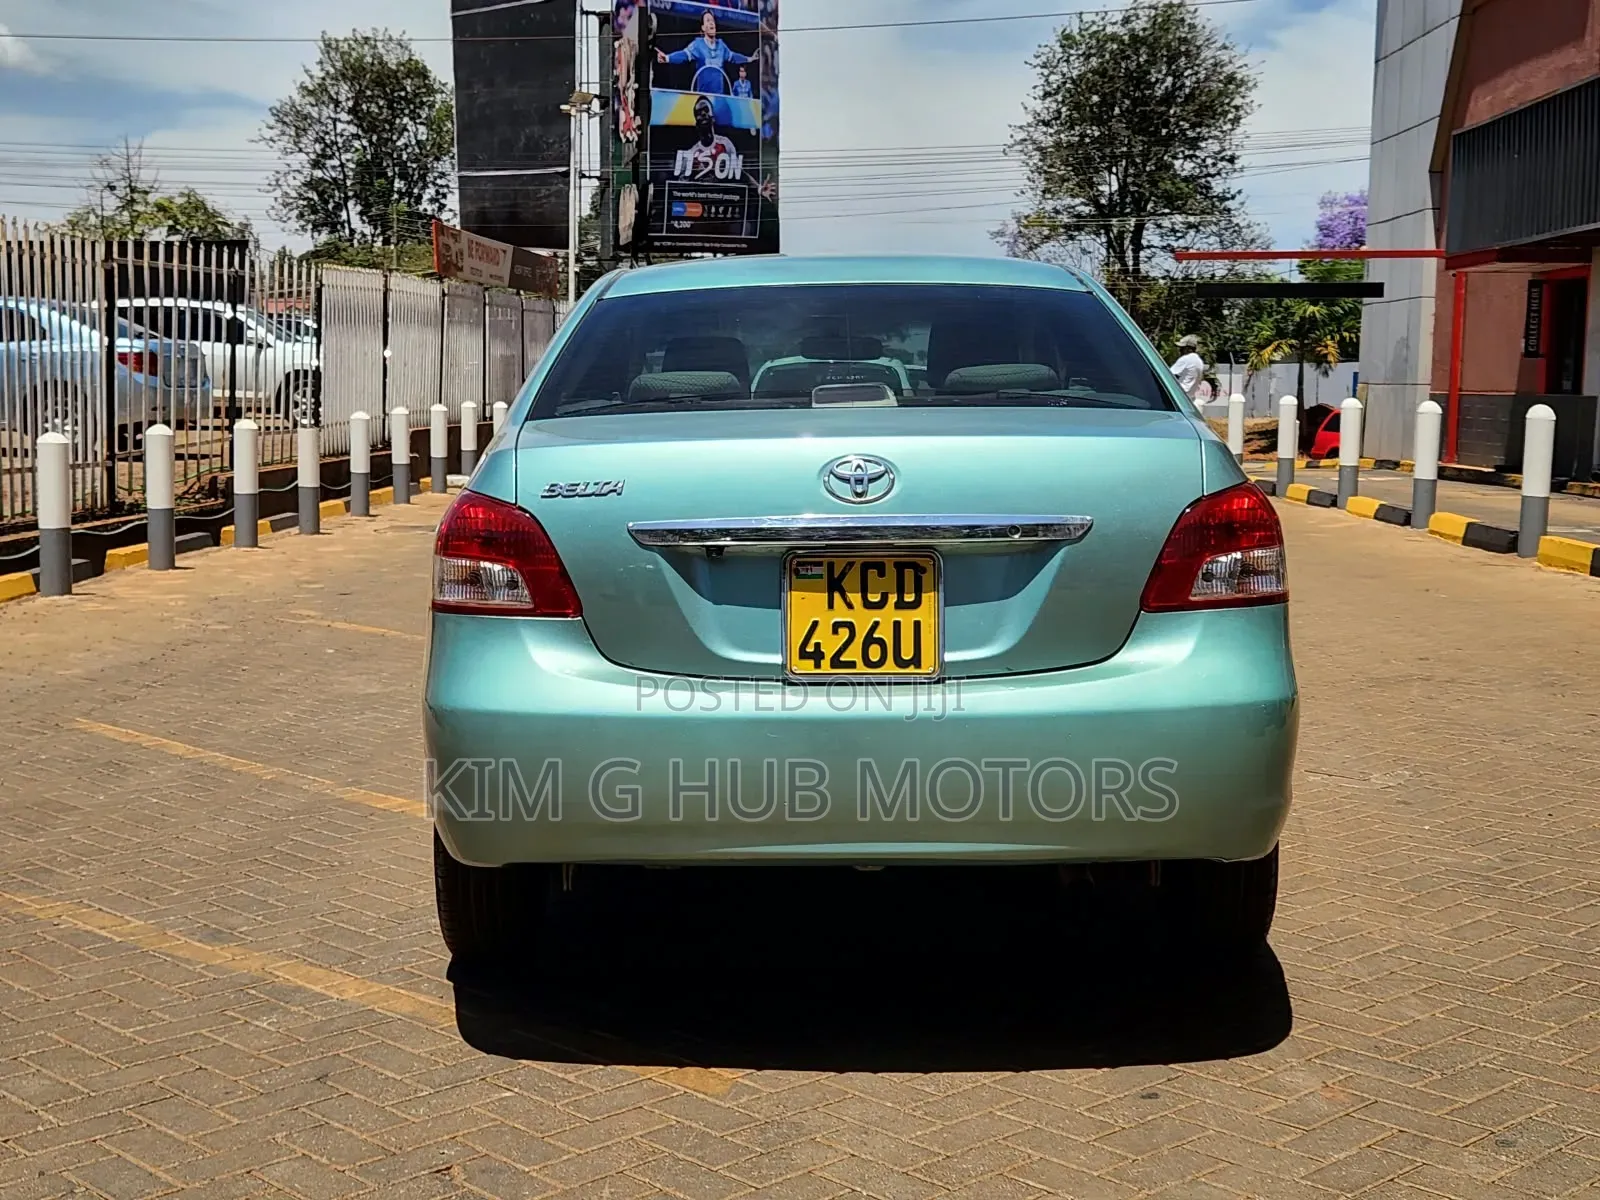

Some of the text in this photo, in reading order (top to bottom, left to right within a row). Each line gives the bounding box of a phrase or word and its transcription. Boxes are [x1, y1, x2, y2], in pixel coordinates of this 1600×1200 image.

[674, 149, 743, 180] IT'S ON
[1528, 288, 1540, 352] COLLECT HERE
[541, 479, 625, 499] BELTA
[827, 561, 924, 610] KCD
[798, 619, 922, 669] 426U
